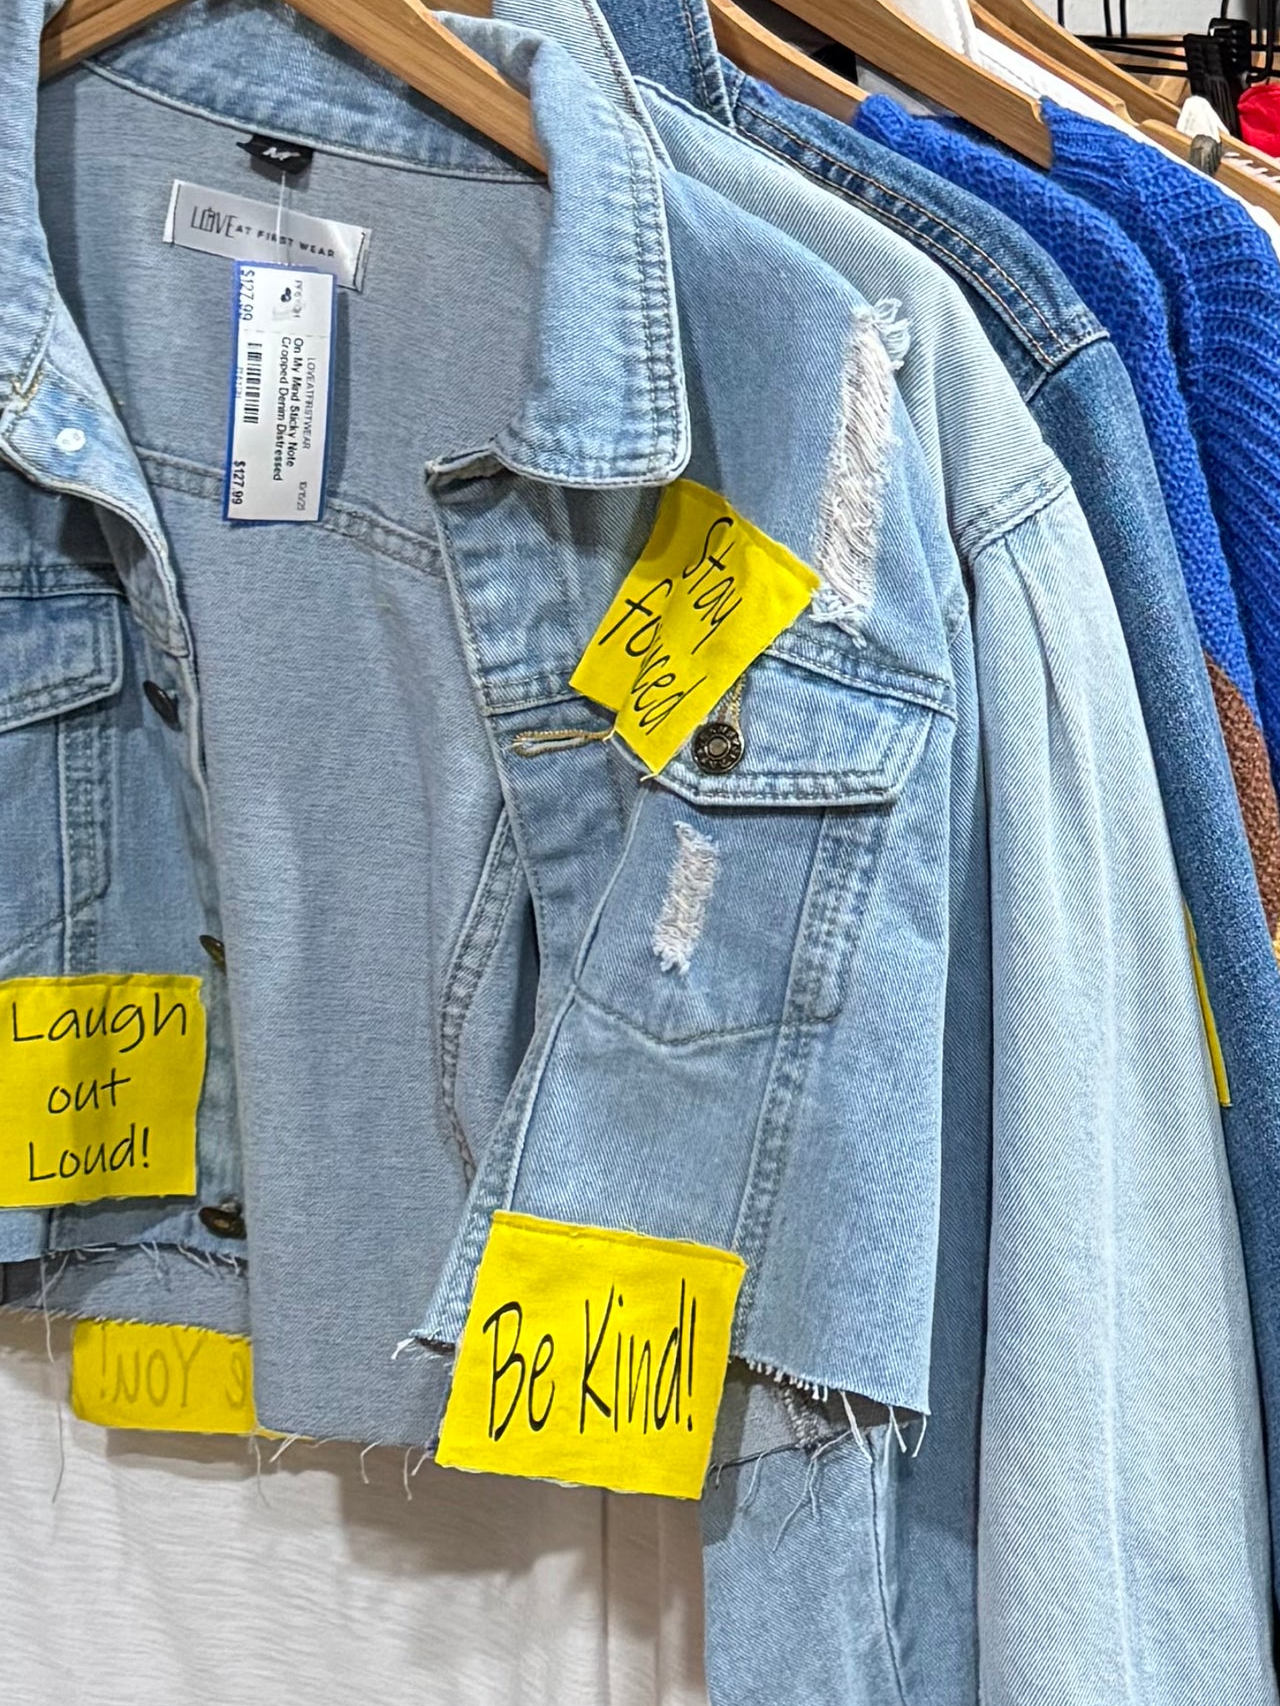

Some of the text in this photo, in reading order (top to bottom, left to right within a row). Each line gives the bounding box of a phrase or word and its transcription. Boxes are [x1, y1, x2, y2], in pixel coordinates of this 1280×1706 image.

[299, 241, 336, 259] WEAR
[292, 337, 304, 354] On
[272, 336, 291, 482] Cropped Denim Distressed
[285, 441, 298, 468] Note
[231, 460, 247, 506] $127.99
[682, 515, 743, 655] Stay
[11, 992, 188, 1054] Laugh
[47, 1067, 131, 1116] out
[28, 1123, 151, 1182] Loud!
[482, 1277, 698, 1442] Be Kind!
